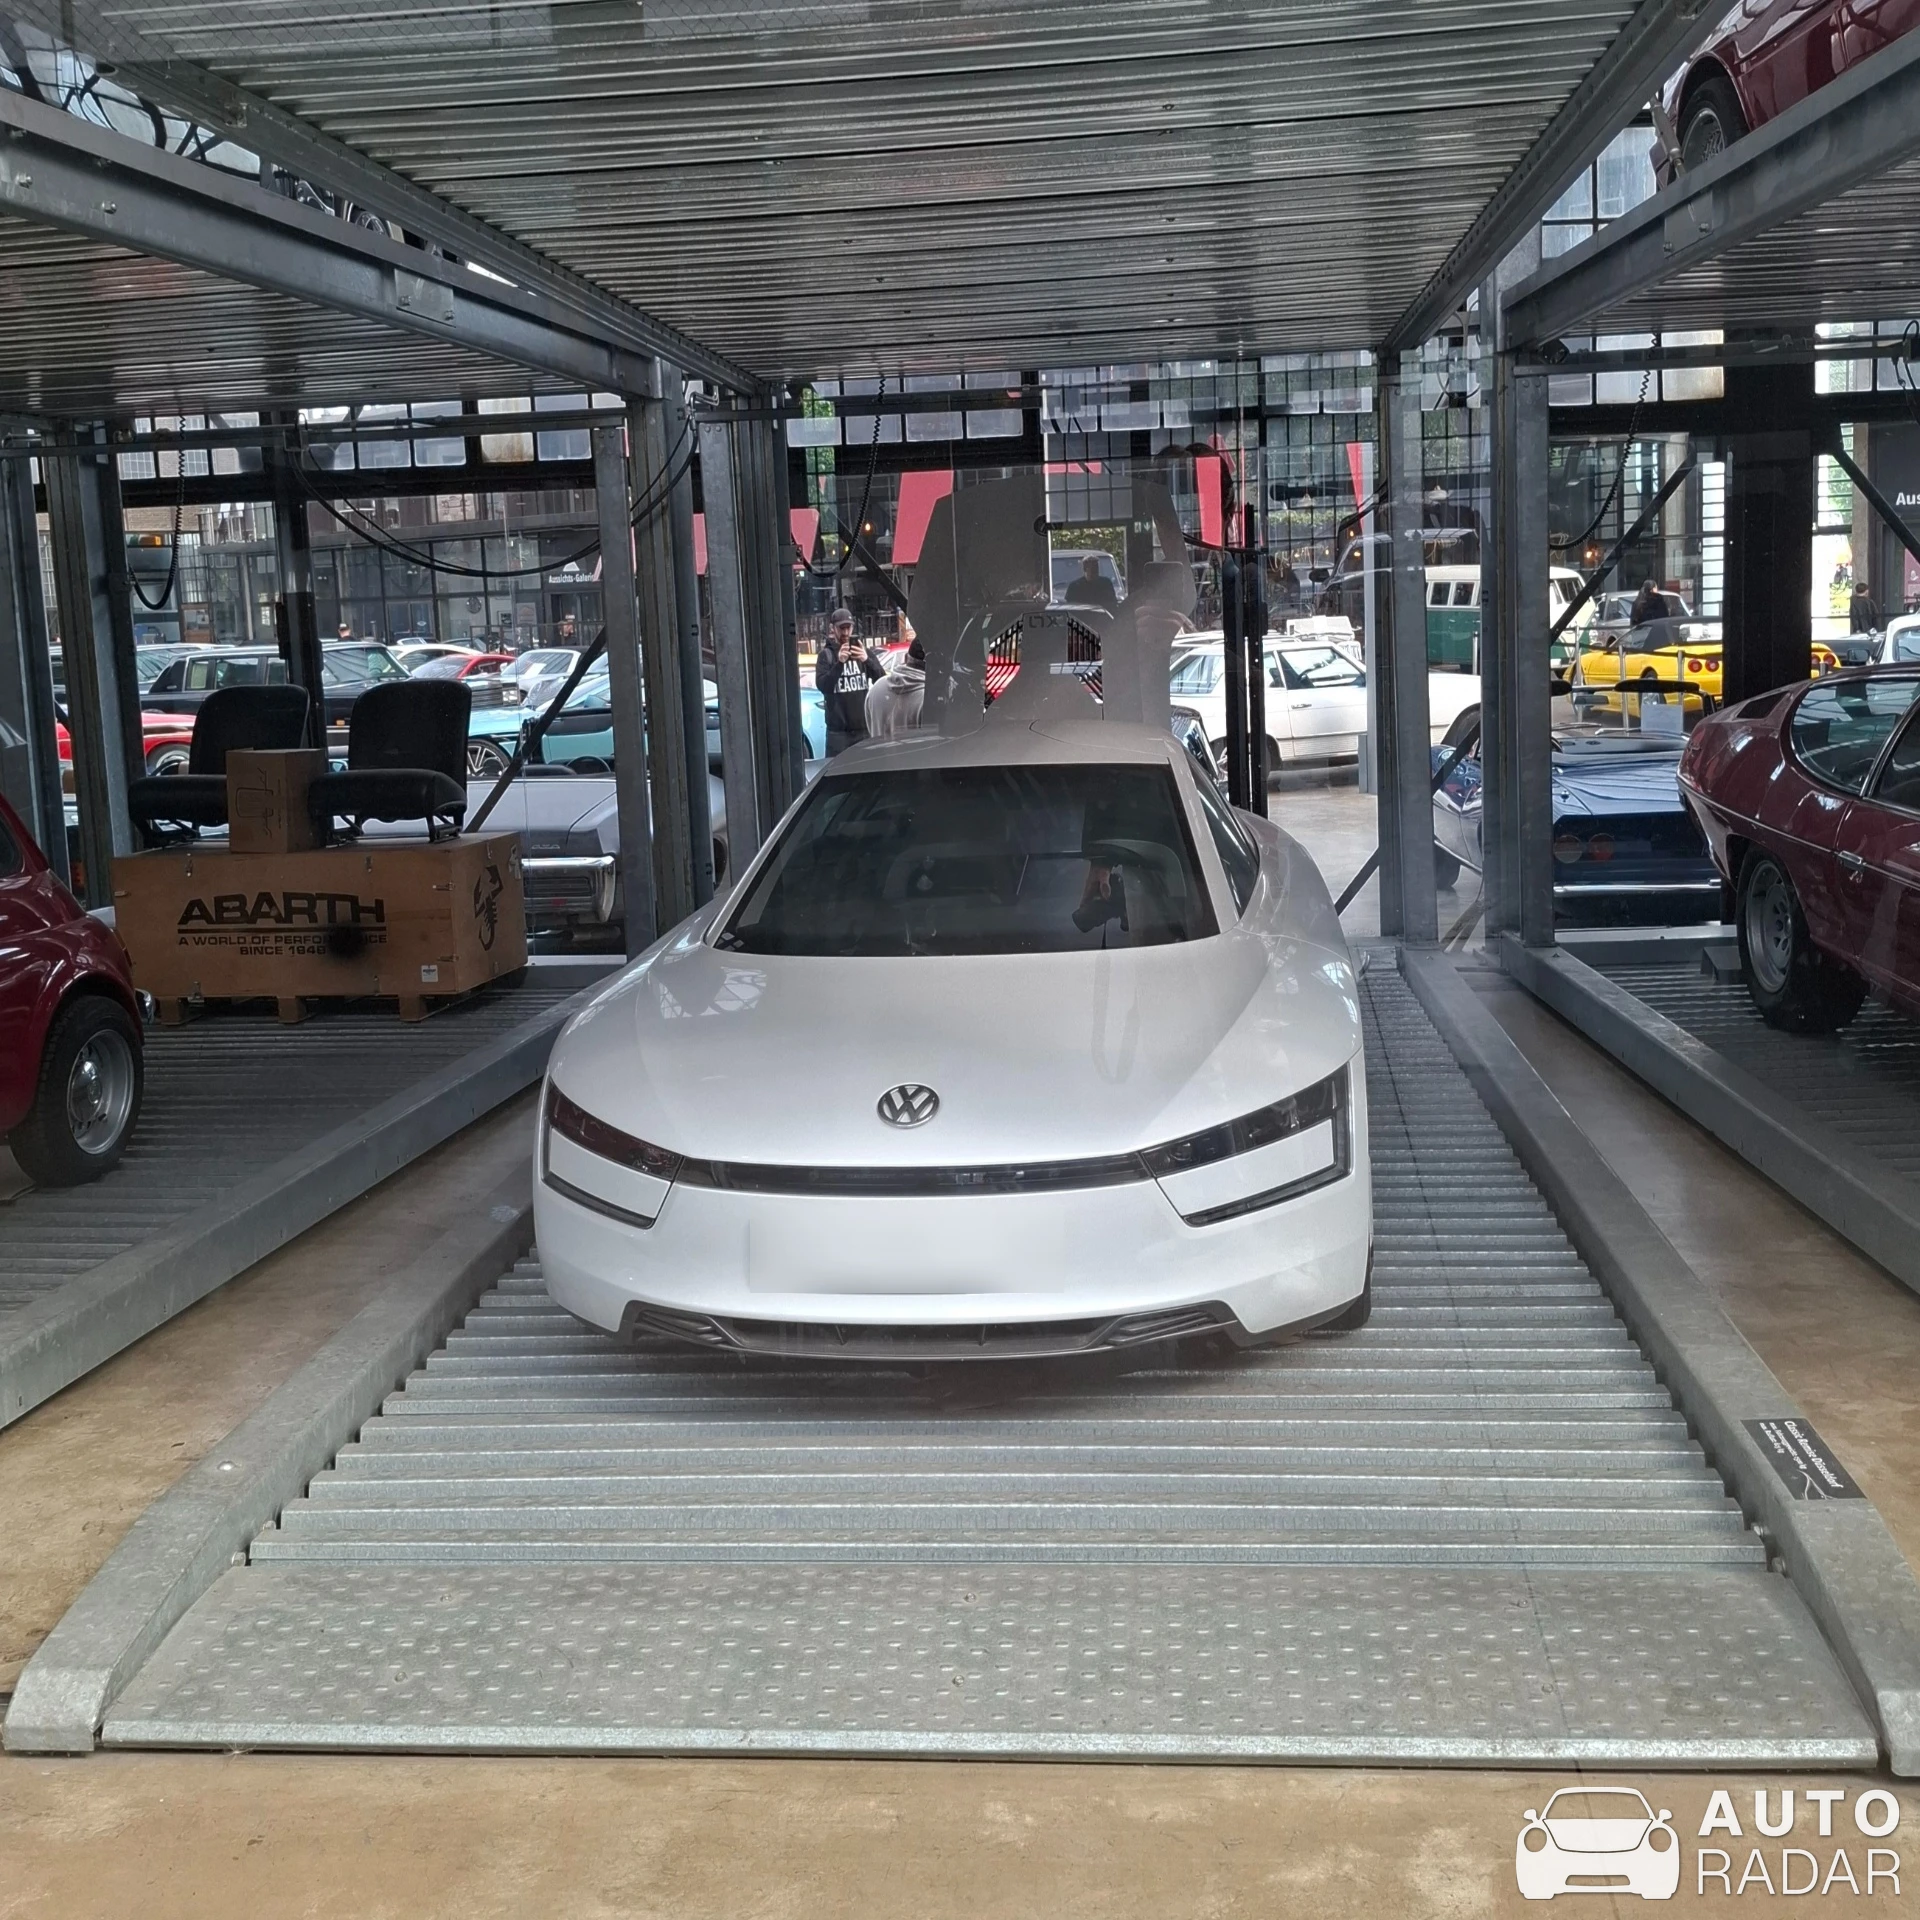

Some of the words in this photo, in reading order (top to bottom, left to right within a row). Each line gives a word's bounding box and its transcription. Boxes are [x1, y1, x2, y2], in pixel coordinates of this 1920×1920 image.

[177, 891, 386, 925] ABARTH
[178, 936, 189, 946] A
[192, 936, 247, 946] WORLD
[251, 935, 270, 945] OF
[274, 934, 388, 945] PERFOCE
[240, 946, 284, 955] SINCE
[877, 1082, 940, 1129] VW
[1784, 1420, 1805, 1439] Classic
[1811, 1457, 1844, 1489] Düsseldorf
